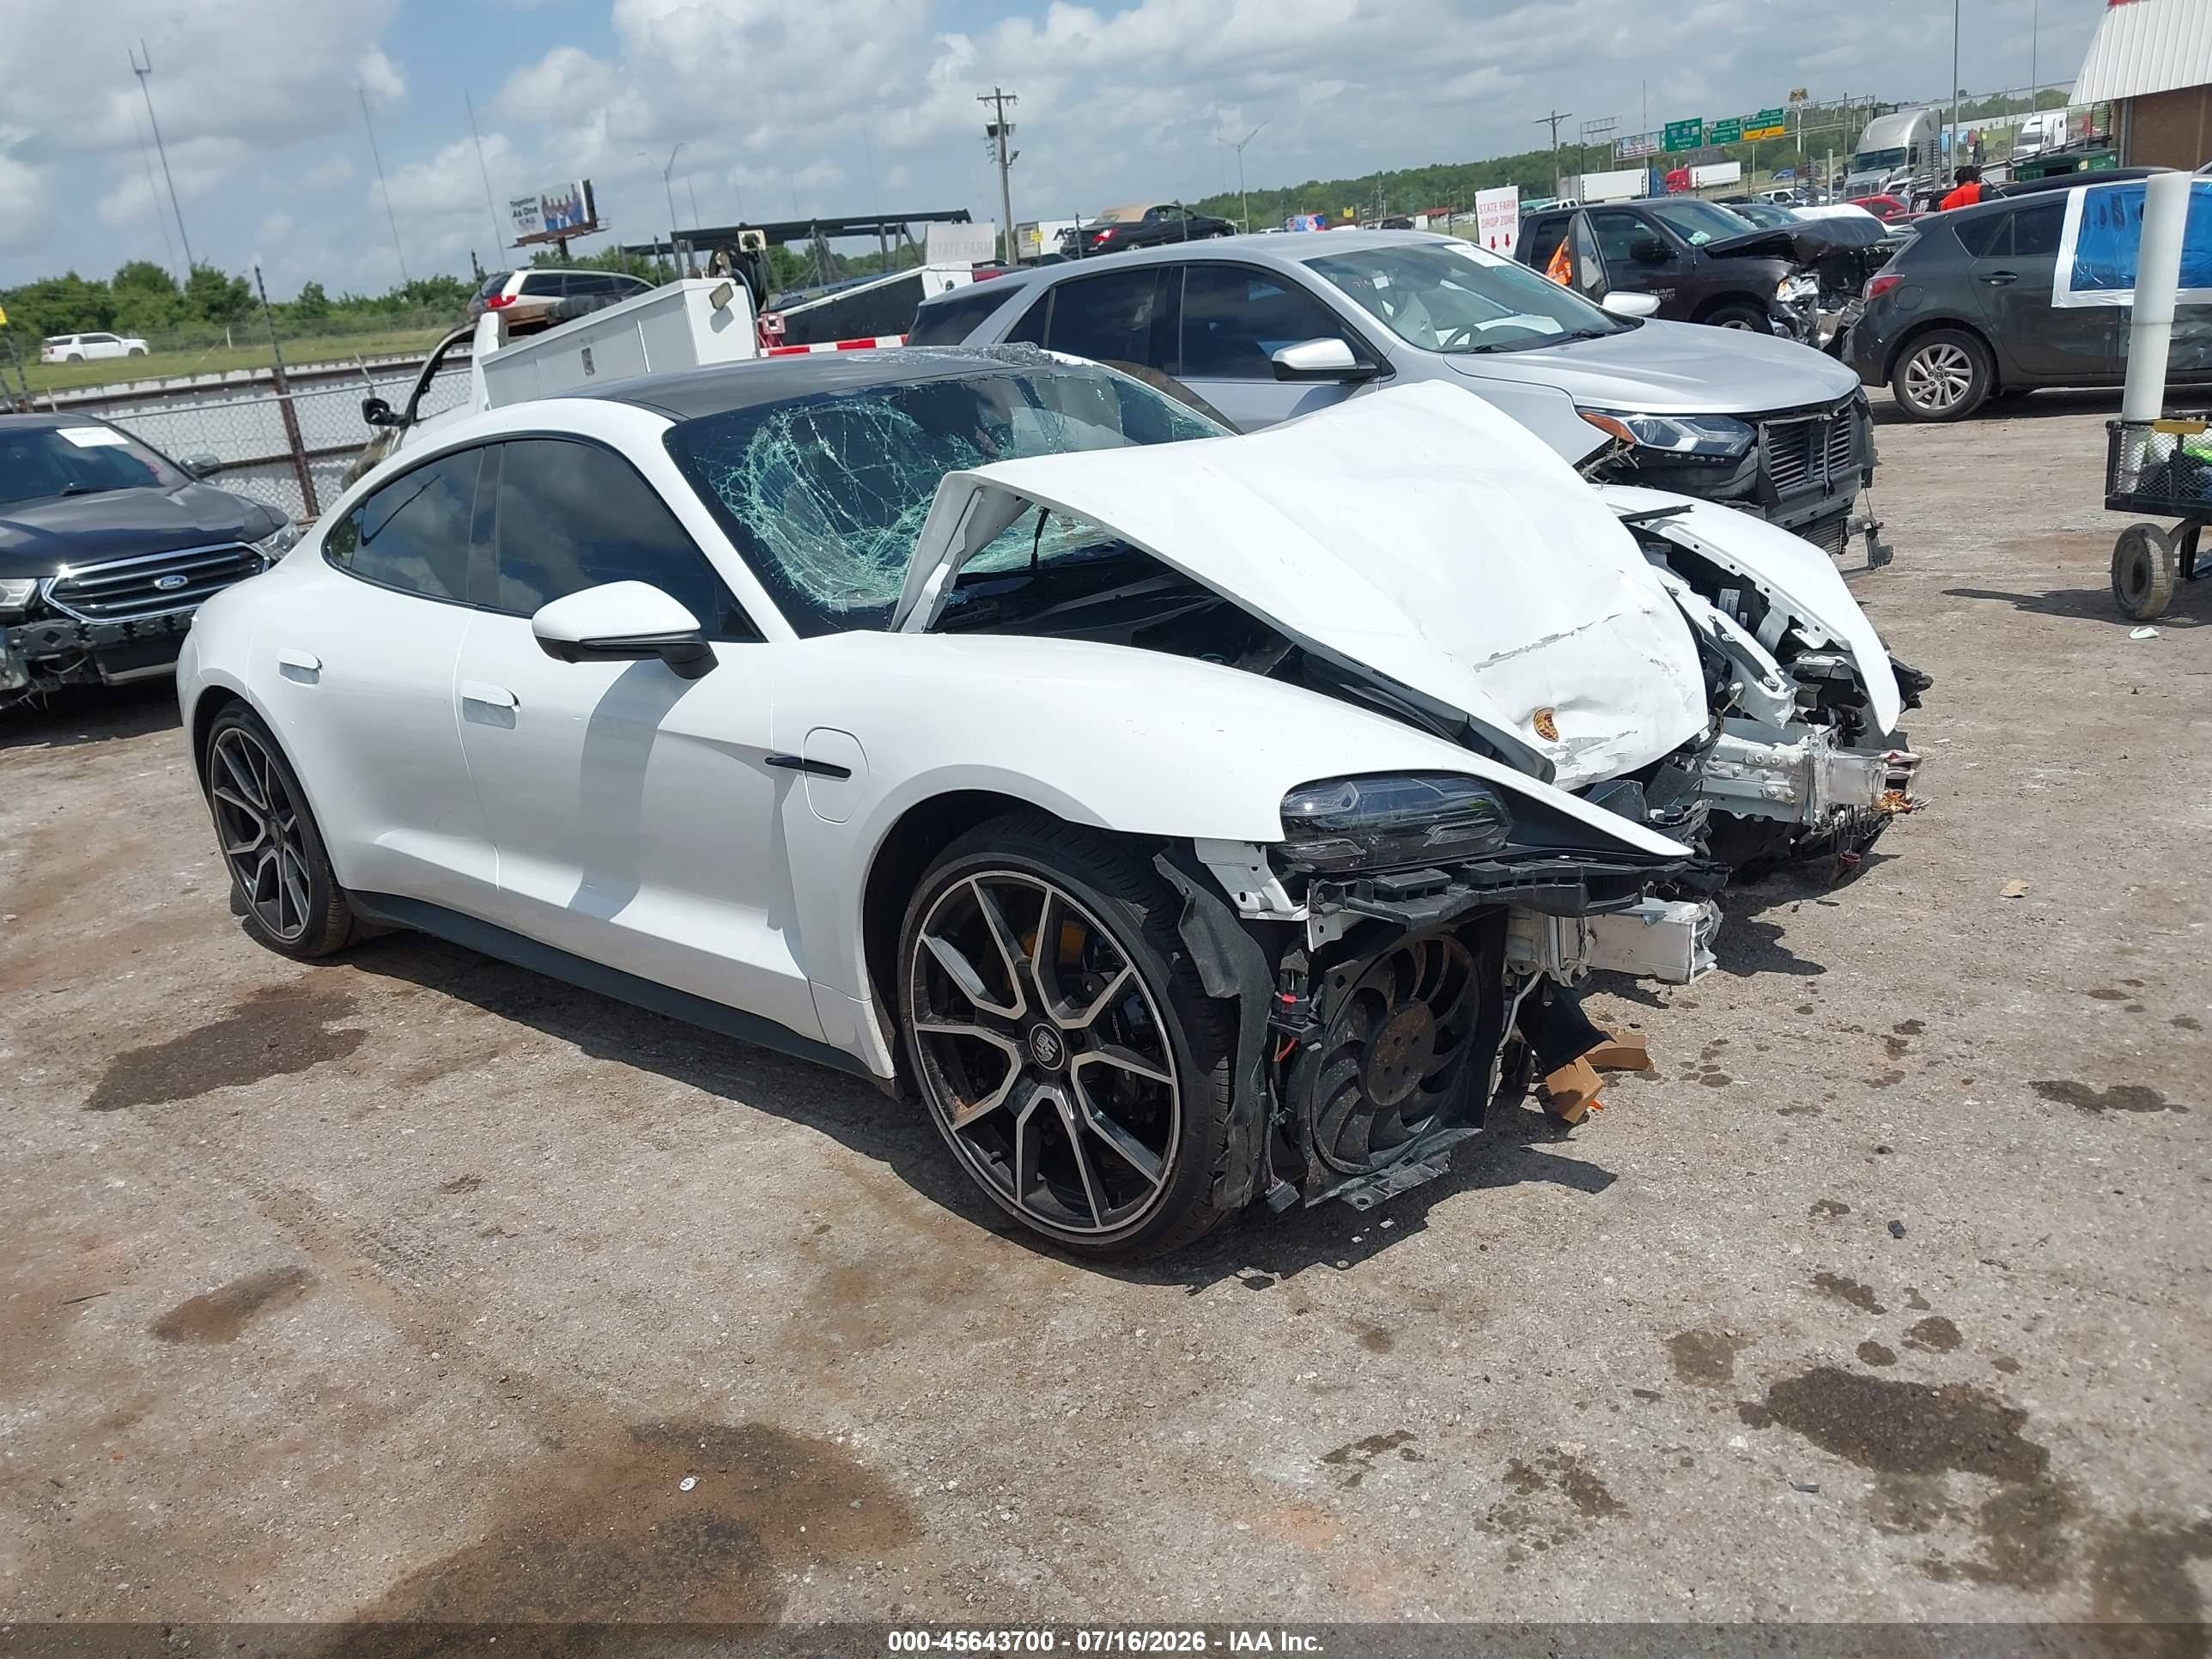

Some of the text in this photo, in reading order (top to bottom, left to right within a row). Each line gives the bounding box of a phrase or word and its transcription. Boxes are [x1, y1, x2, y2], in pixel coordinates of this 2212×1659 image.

[513, 210, 523, 218] As
[1479, 199, 1516, 215] STATE FARM
[1481, 213, 1516, 229] DROP ZONE
[930, 240, 994, 257] STATE FARM
